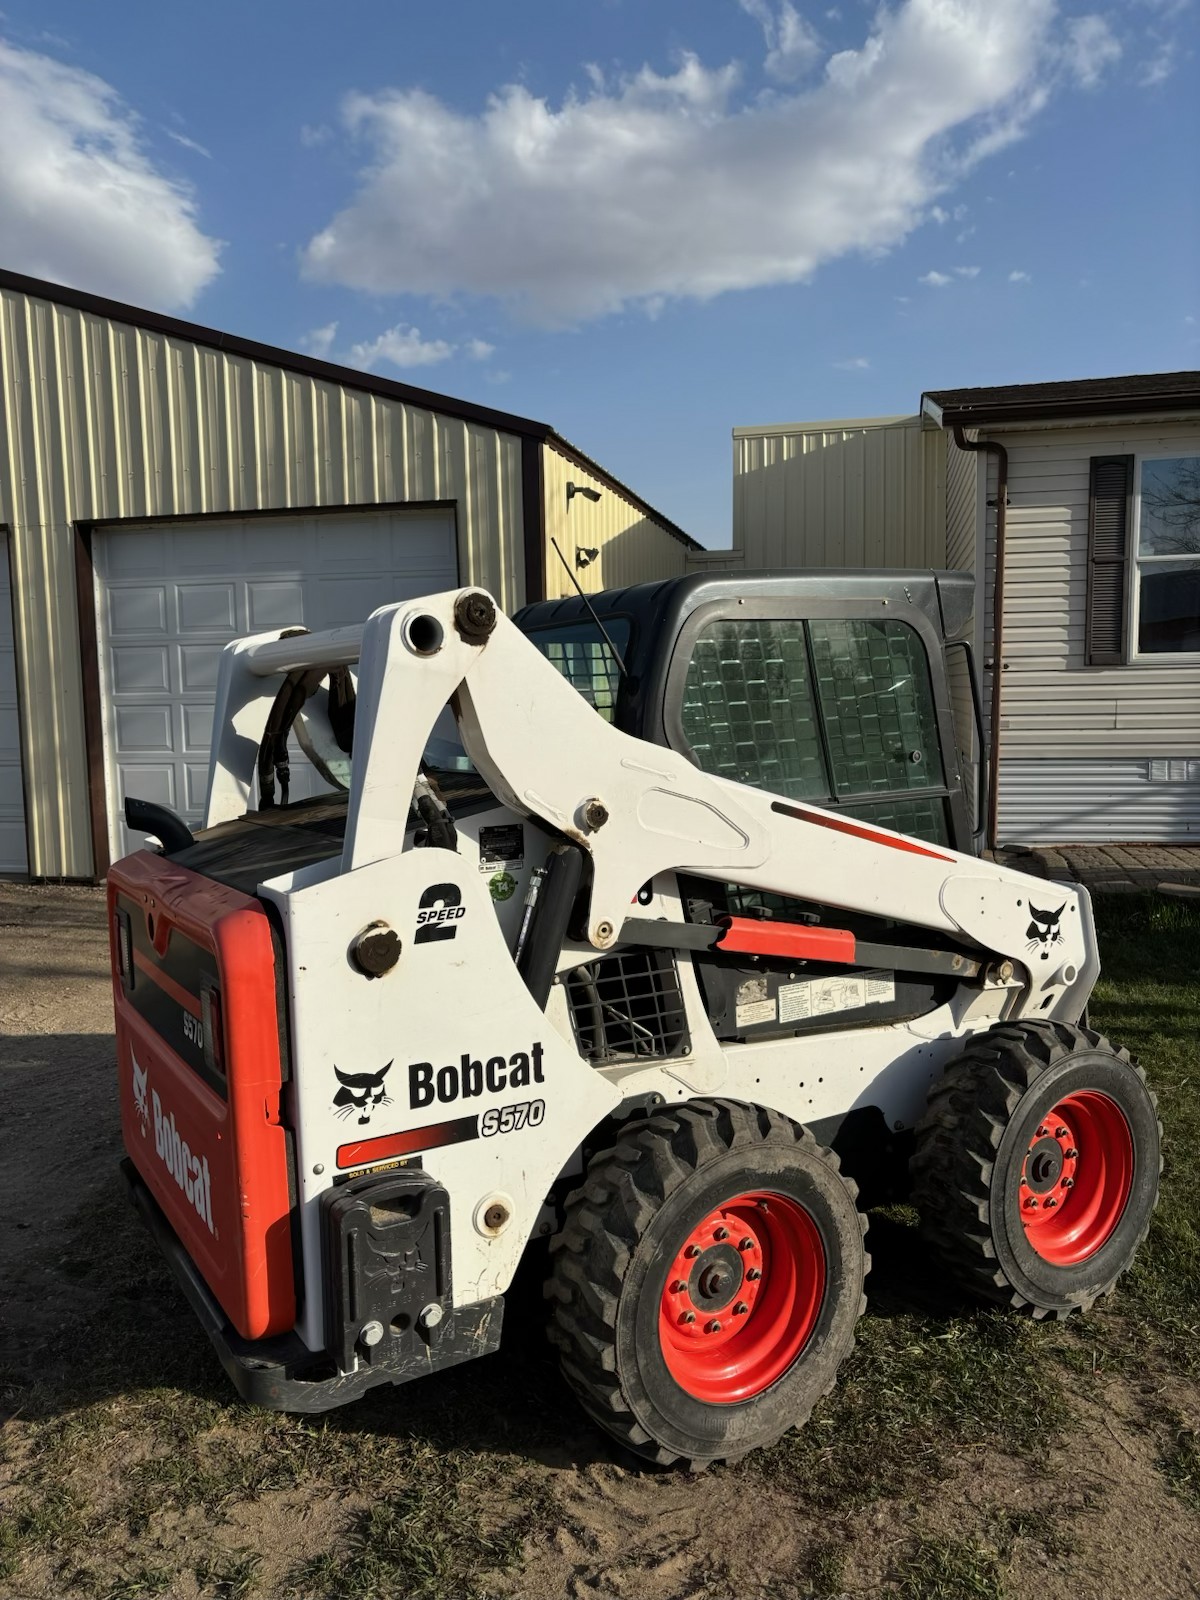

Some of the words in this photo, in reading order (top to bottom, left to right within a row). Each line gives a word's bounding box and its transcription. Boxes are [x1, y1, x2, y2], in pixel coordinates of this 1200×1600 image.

[496, 881, 509, 892] T4
[414, 883, 462, 944] 2
[416, 907, 466, 924] SPEED
[183, 1010, 203, 1049] S570
[408, 1042, 545, 1109] Bobcat
[481, 1099, 545, 1137] S570
[152, 1088, 215, 1236] Bobcat
[349, 1170, 364, 1179] SOLD
[372, 1161, 399, 1174] SERVICED
